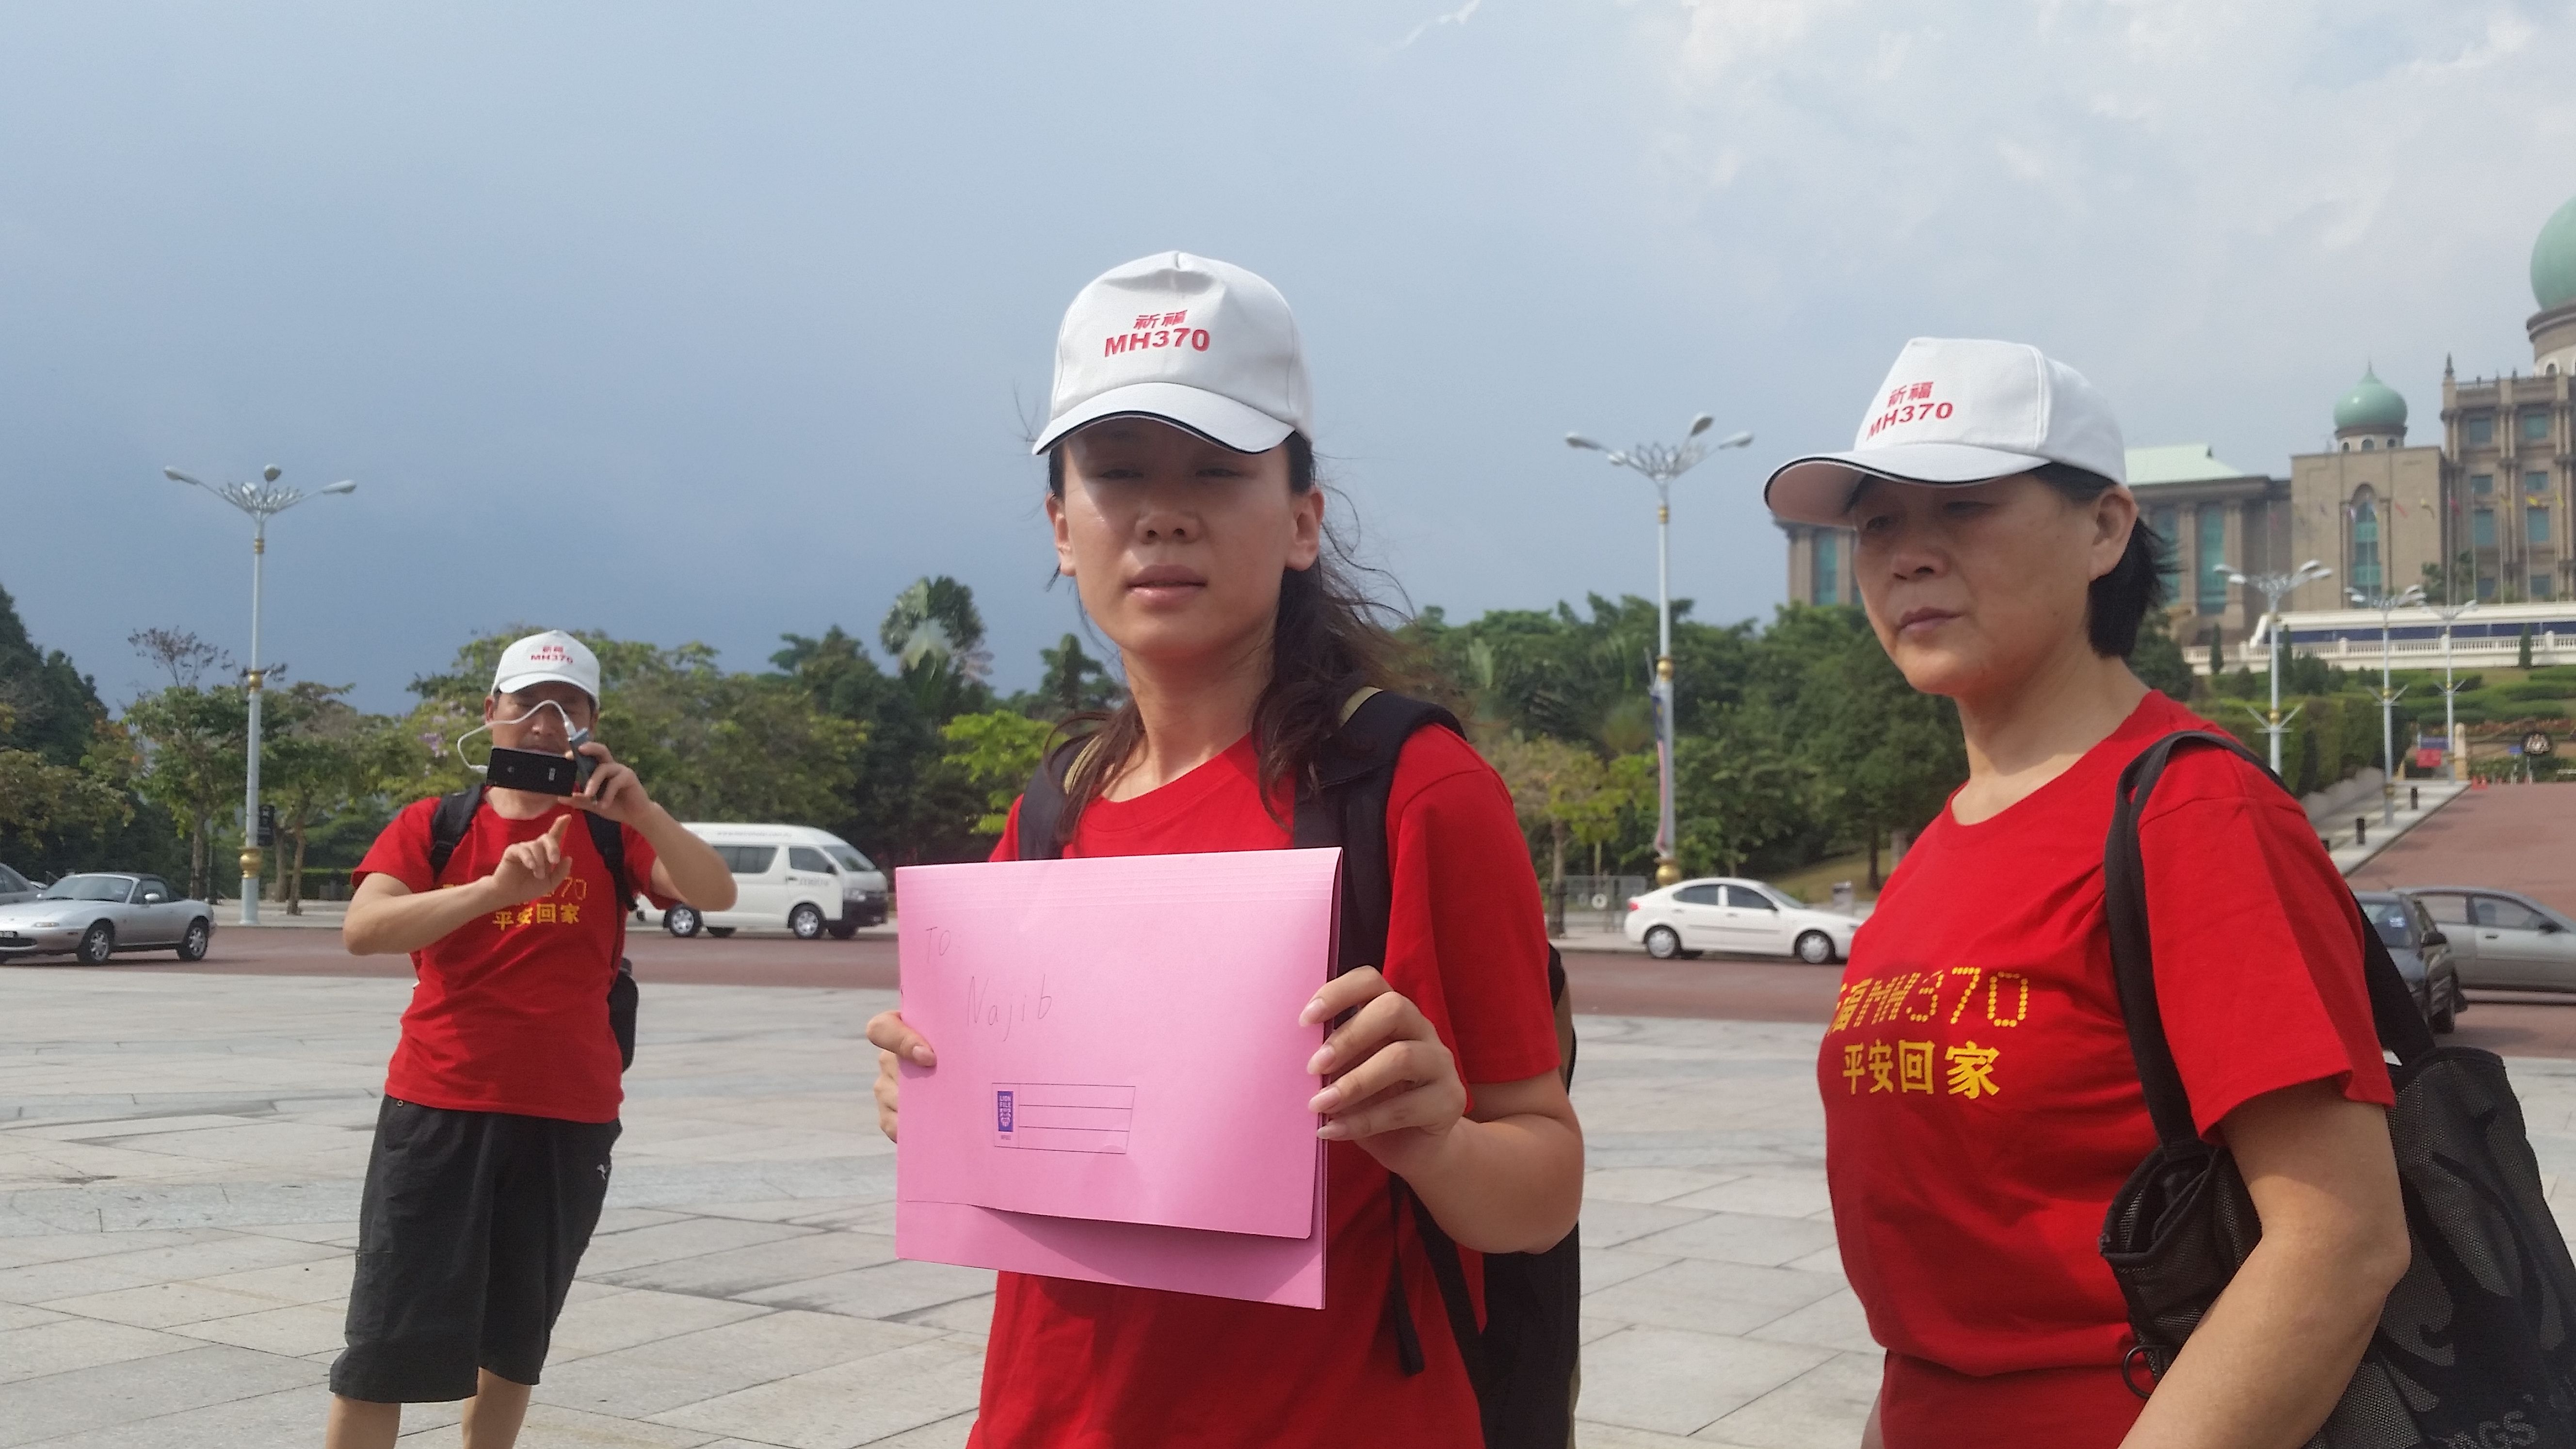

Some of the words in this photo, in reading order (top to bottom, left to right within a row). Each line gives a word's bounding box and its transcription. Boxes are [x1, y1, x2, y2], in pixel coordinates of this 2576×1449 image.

[1105, 328, 1210, 357] MH370
[1867, 402, 1953, 440] MH370
[967, 974, 1052, 1042] Najib
[1843, 1039, 2000, 1099] 平安回家
